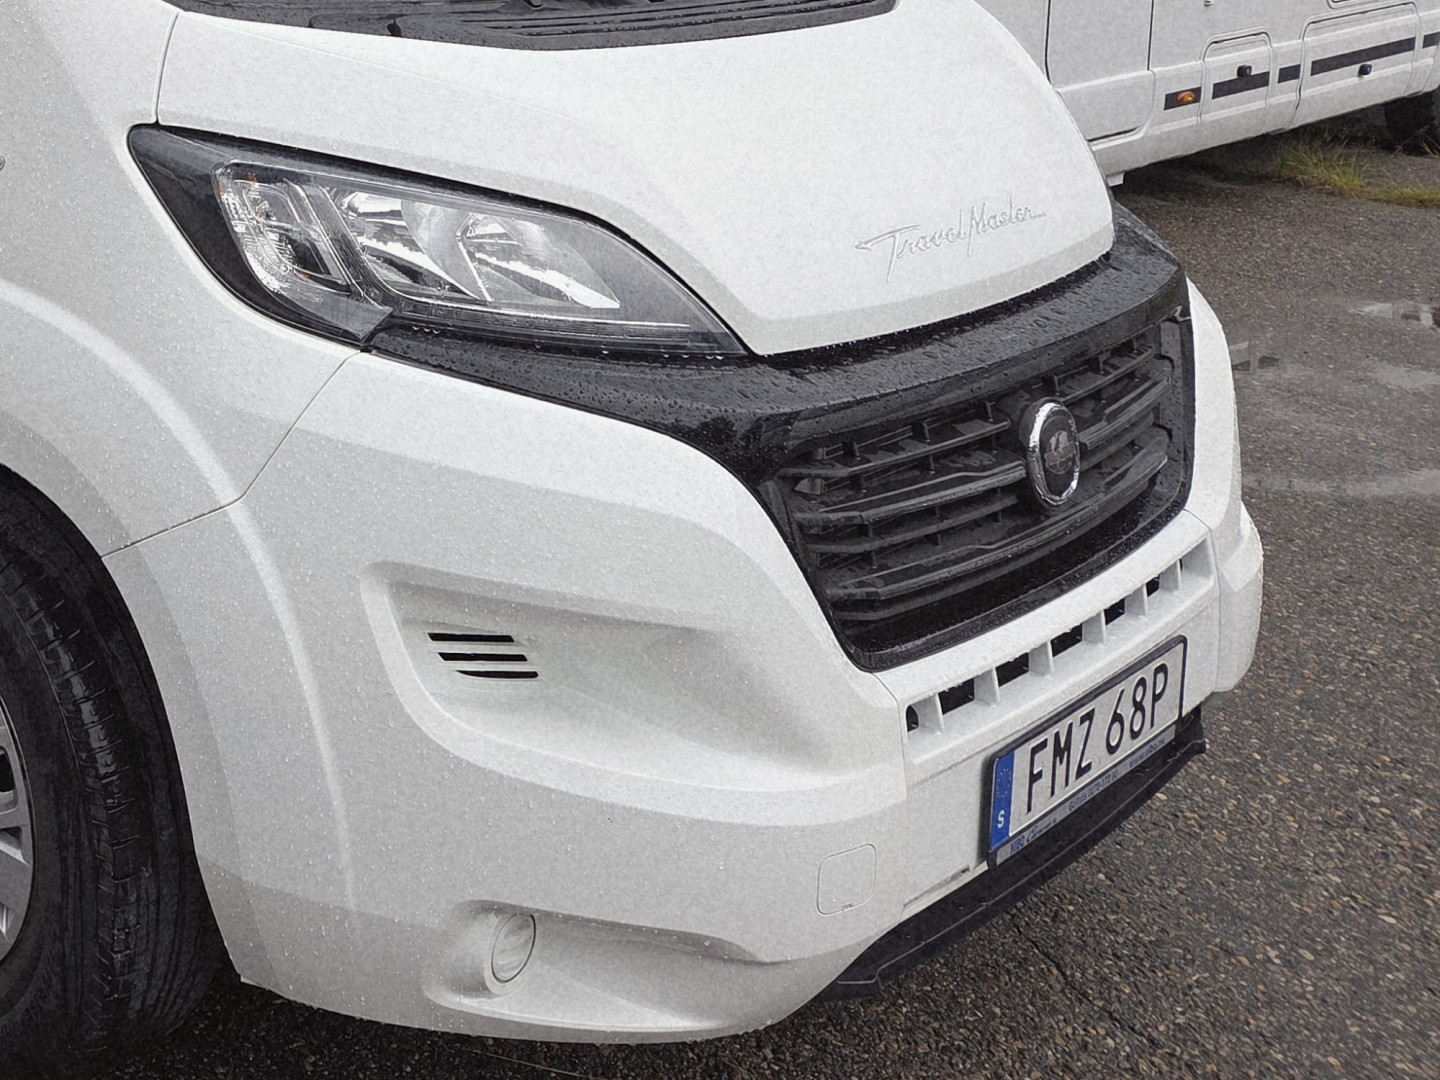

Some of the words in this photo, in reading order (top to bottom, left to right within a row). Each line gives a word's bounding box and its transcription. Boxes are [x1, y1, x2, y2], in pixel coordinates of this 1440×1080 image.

[1026, 707, 1096, 814] FMZ
[1105, 662, 1169, 756] 68P
[997, 809, 1006, 829] S
